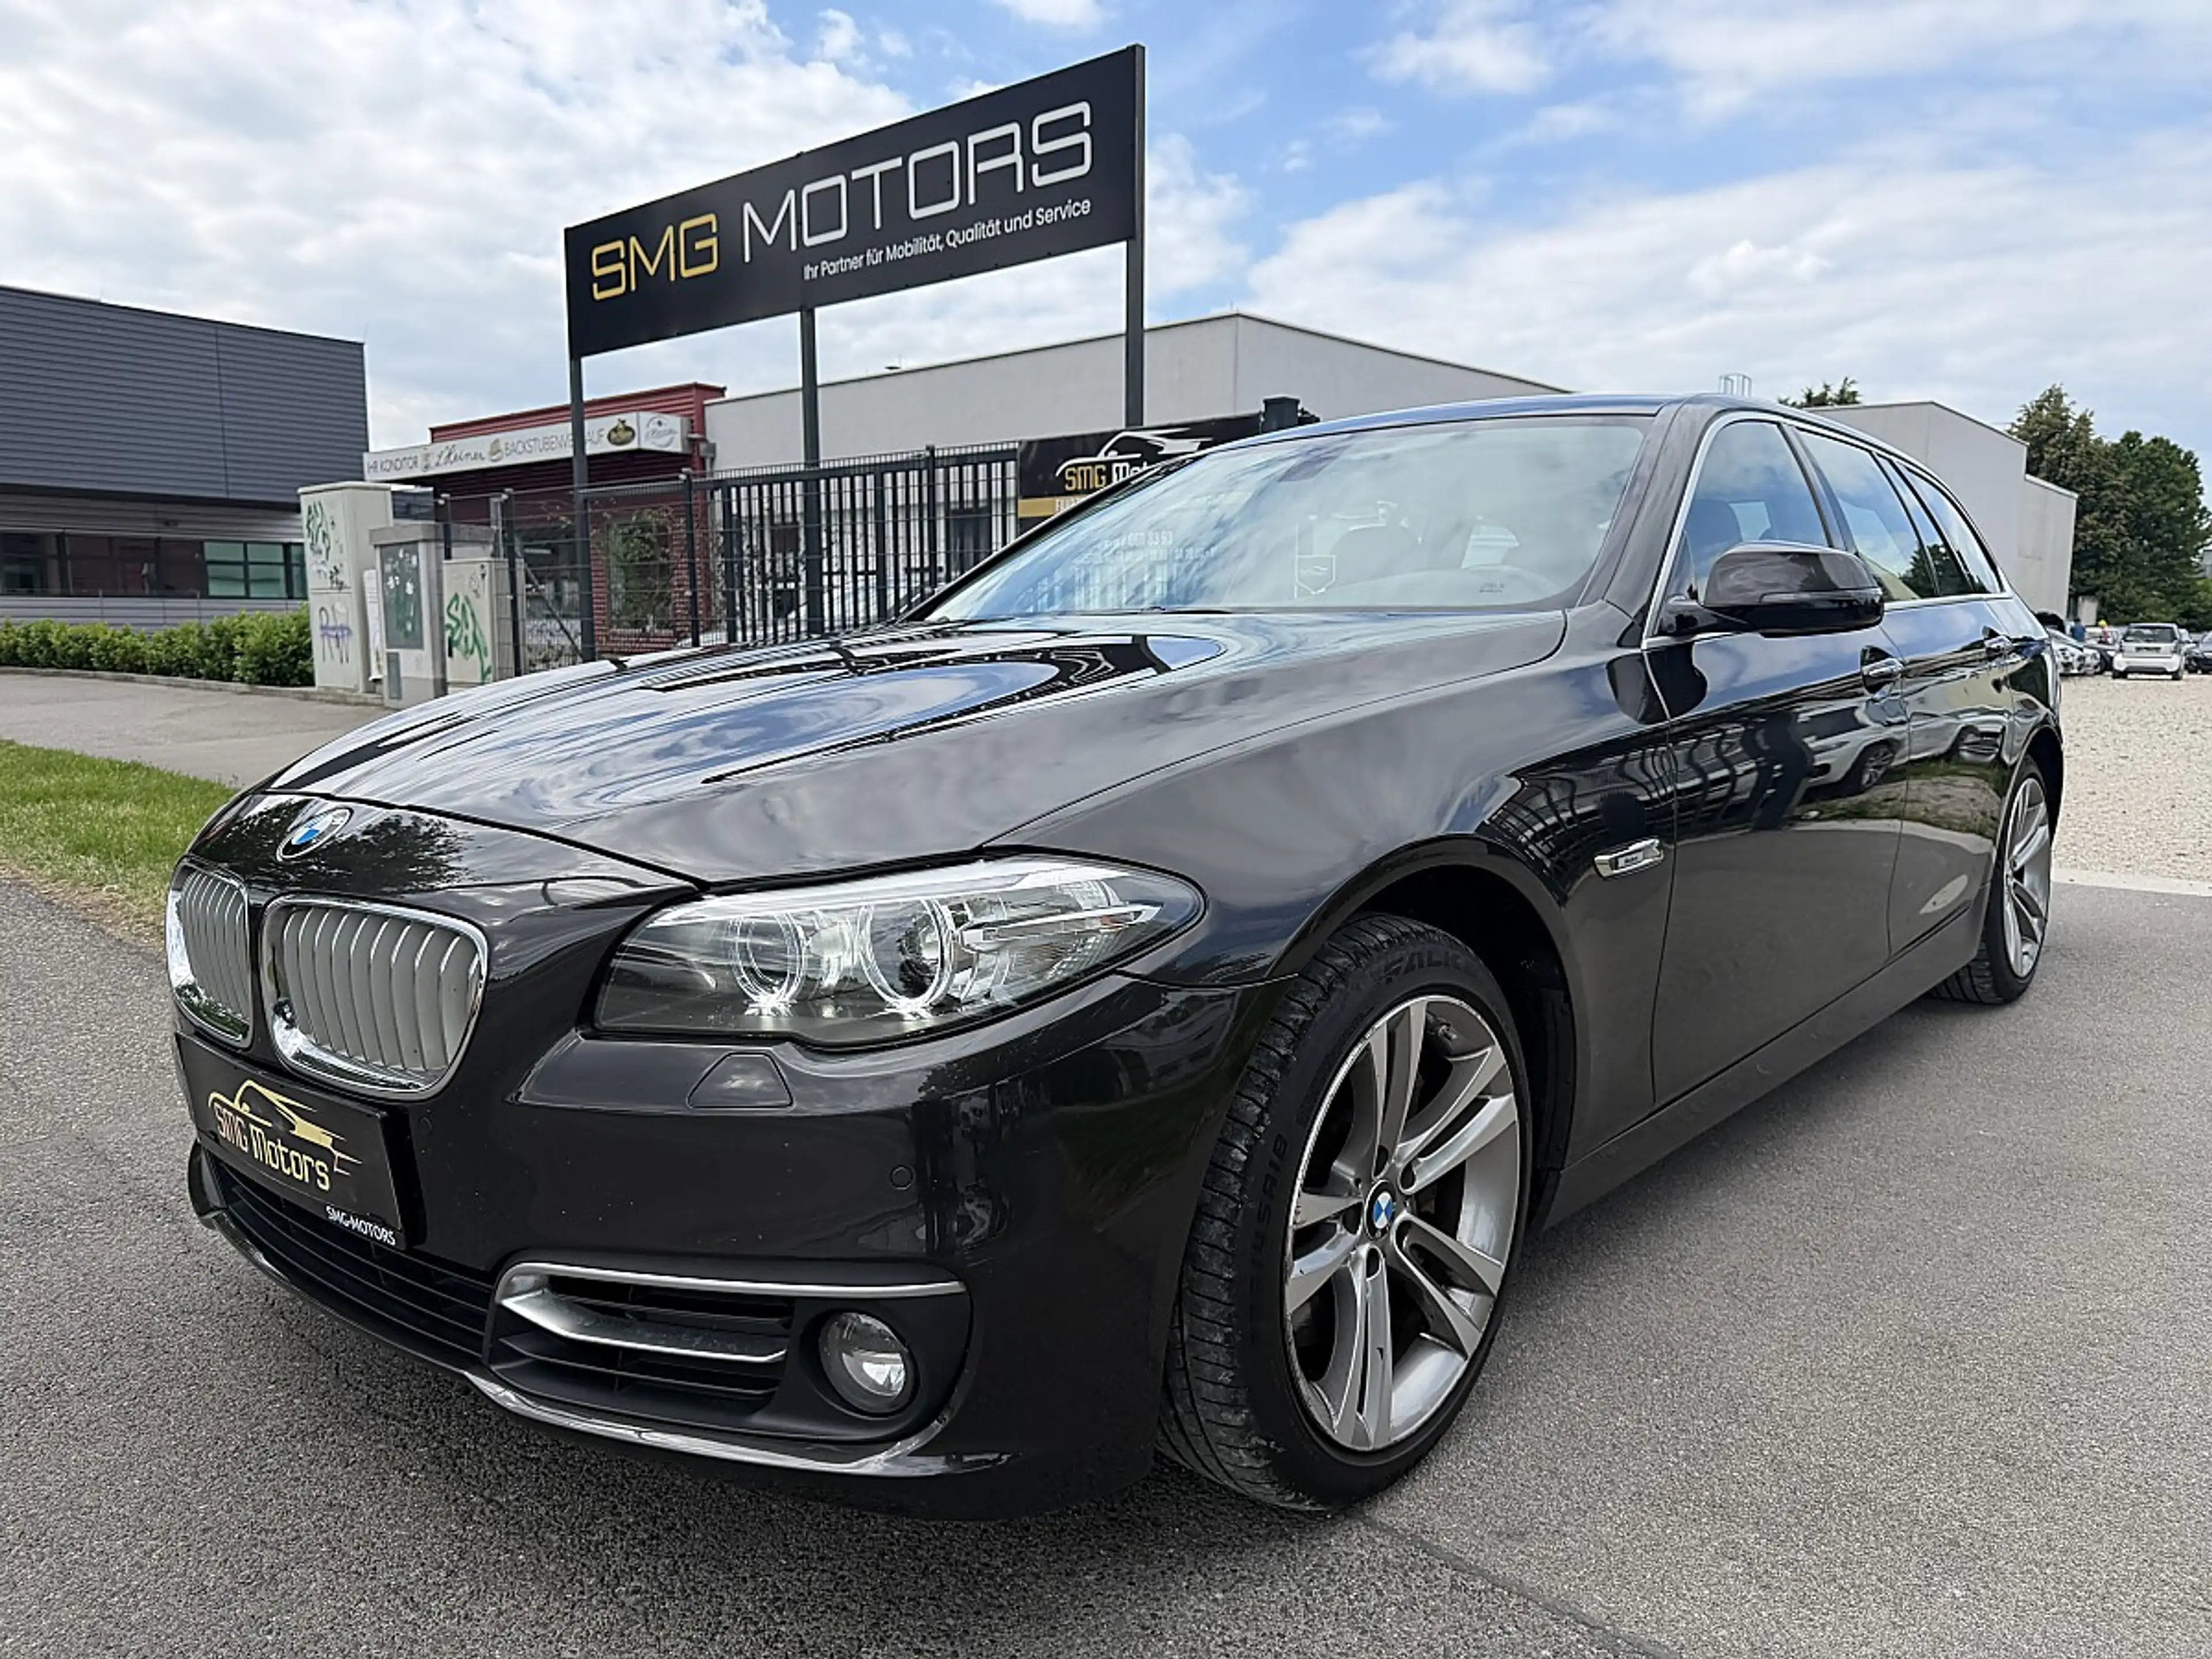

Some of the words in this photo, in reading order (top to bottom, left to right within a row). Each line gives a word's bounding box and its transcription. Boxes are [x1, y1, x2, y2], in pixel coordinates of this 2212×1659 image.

[591, 213, 718, 301] SMG
[742, 101, 1092, 264] MOTORS
[803, 263, 819, 281] Ihr
[820, 253, 865, 277] Partner
[866, 247, 884, 267] für
[885, 233, 944, 263] Mobilität,
[945, 218, 1002, 249] Qualität
[1003, 209, 1033, 233] und
[1036, 198, 1091, 226] Service
[1065, 464, 1107, 491] SMG
[213, 1101, 249, 1153] SMG
[249, 1123, 330, 1192] Motors
[325, 1205, 396, 1247] SMG-MOTORS
